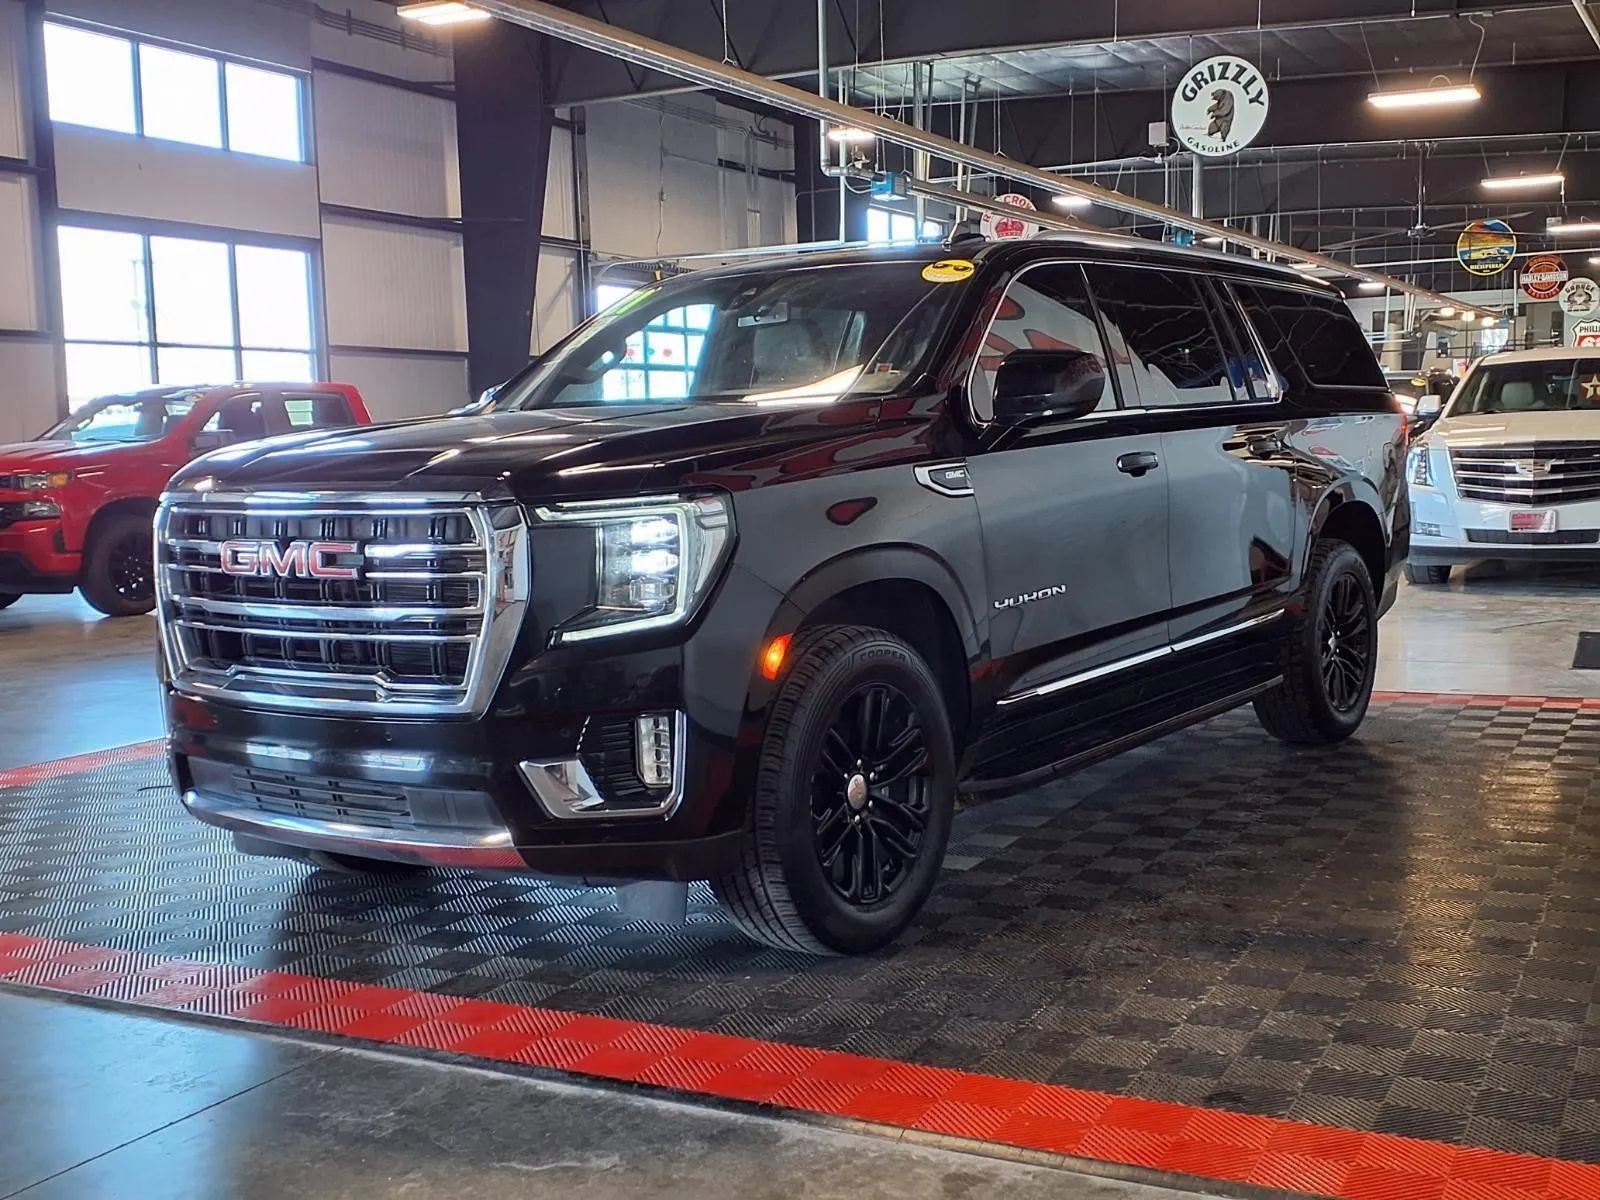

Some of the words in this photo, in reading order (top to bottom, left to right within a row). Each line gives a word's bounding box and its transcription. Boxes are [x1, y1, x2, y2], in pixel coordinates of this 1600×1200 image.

[1181, 62, 1265, 106] GRIZZLY
[1187, 136, 1240, 153] GASOLINE
[1003, 195, 1034, 209] CROW
[946, 470, 965, 479] GMC
[221, 540, 358, 578] GMC
[994, 584, 1066, 608] YUKON
